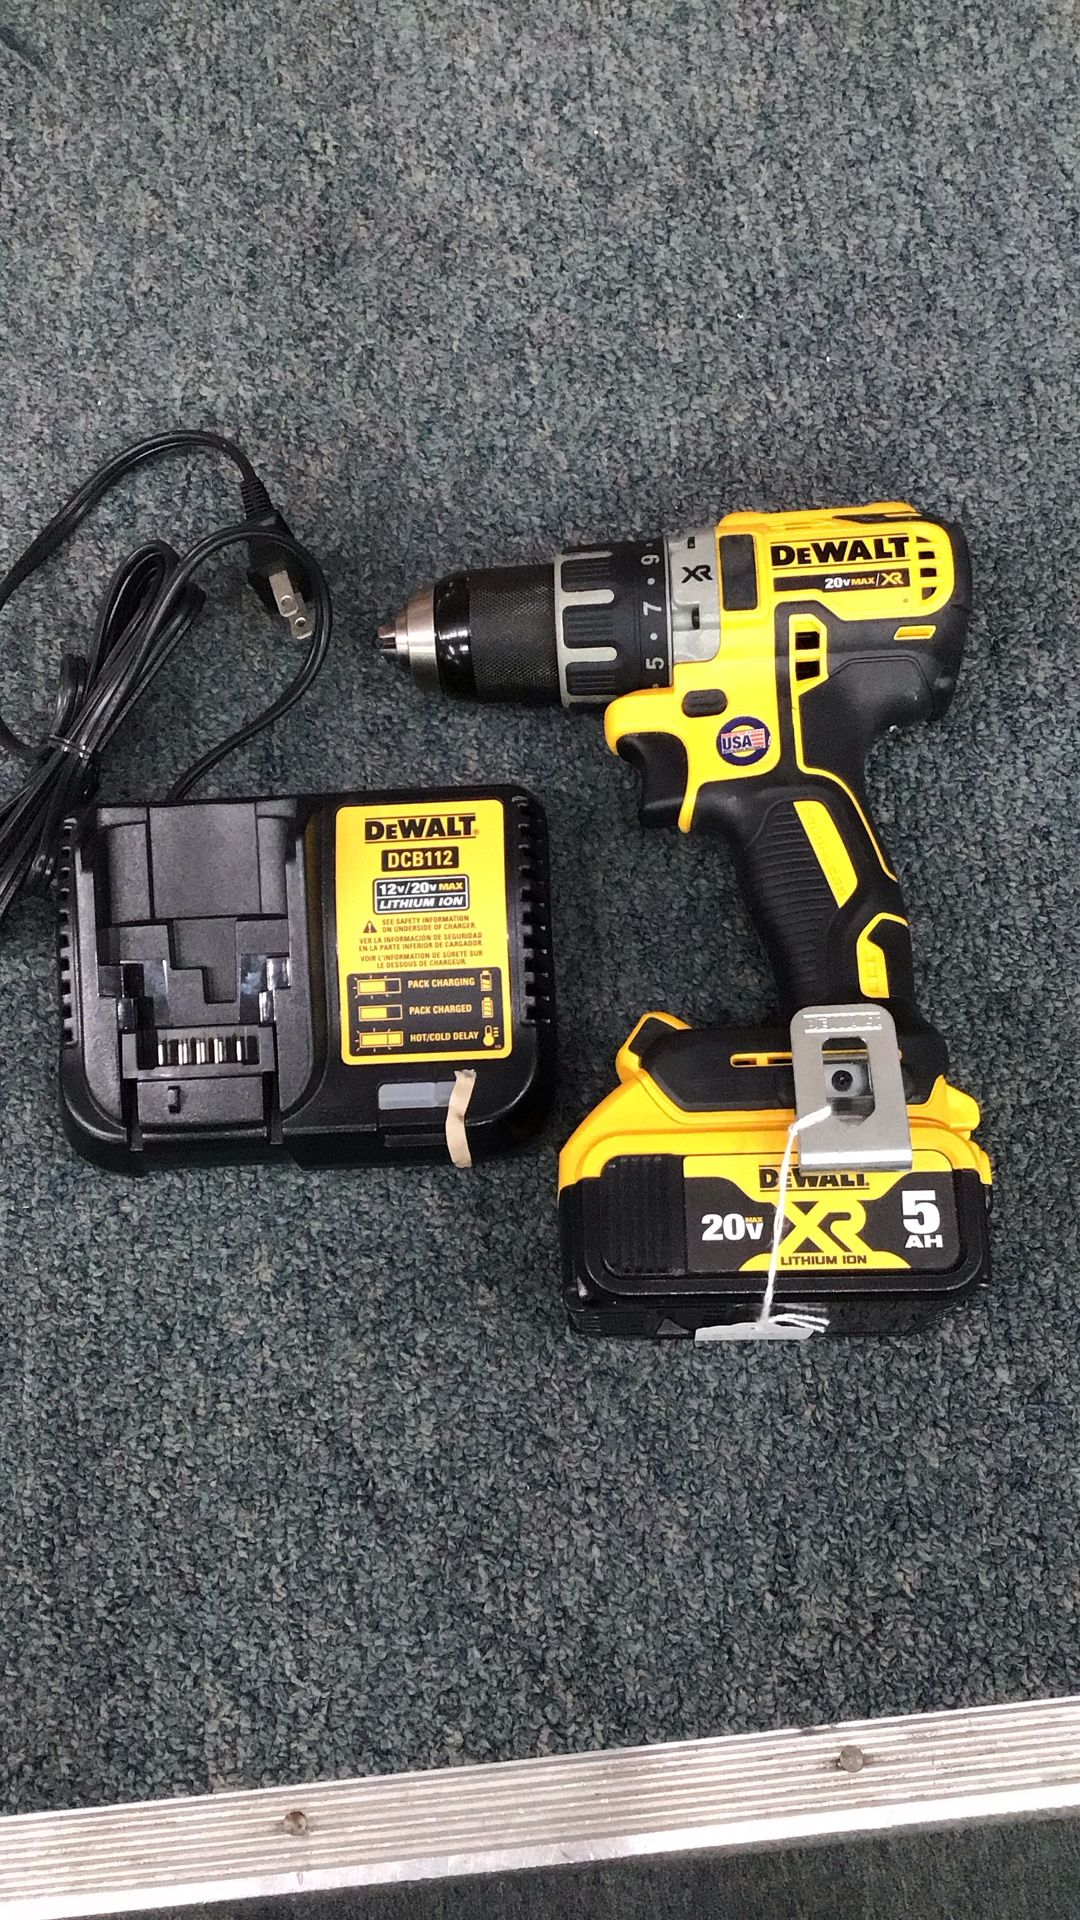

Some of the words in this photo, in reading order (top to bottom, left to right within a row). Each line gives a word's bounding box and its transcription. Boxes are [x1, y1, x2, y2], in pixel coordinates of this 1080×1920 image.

[770, 536, 909, 567] DEWALT
[640, 554, 660, 565] 9
[681, 564, 713, 584] XR
[824, 577, 851, 589] 20V
[851, 577, 875, 586] MAX
[642, 601, 662, 616] 7
[645, 657, 665, 670] 5
[722, 734, 752, 750] USA
[364, 815, 476, 841] DEWALT
[387, 850, 453, 868] DCB112
[379, 881, 437, 895] 12V/20V
[438, 882, 464, 891] MAX
[379, 898, 435, 910] LITHIUM
[438, 897, 464, 906] ION
[395, 917, 420, 925] SAFETY
[422, 915, 470, 924] INFORMATION
[384, 934, 432, 943] INFORMACIÓN
[443, 931, 483, 940] SEGURIDAD
[378, 952, 430, 961] L'INFORMATION
[386, 960, 417, 968] DESSOUS
[407, 979, 430, 988] PACK
[431, 977, 476, 987] CHARGING
[409, 1005, 431, 1015] PACK
[432, 1004, 473, 1014] CHARGED
[410, 1032, 451, 1042] HOT/COLD
[453, 1031, 479, 1041] DELAY
[901, 1190, 941, 1235] 5
[701, 1214, 764, 1241] 20V
[774, 1200, 873, 1253] XR
[904, 1234, 943, 1248] AH
[780, 1255, 838, 1266] LITHIUM
[842, 1254, 867, 1265] ION
